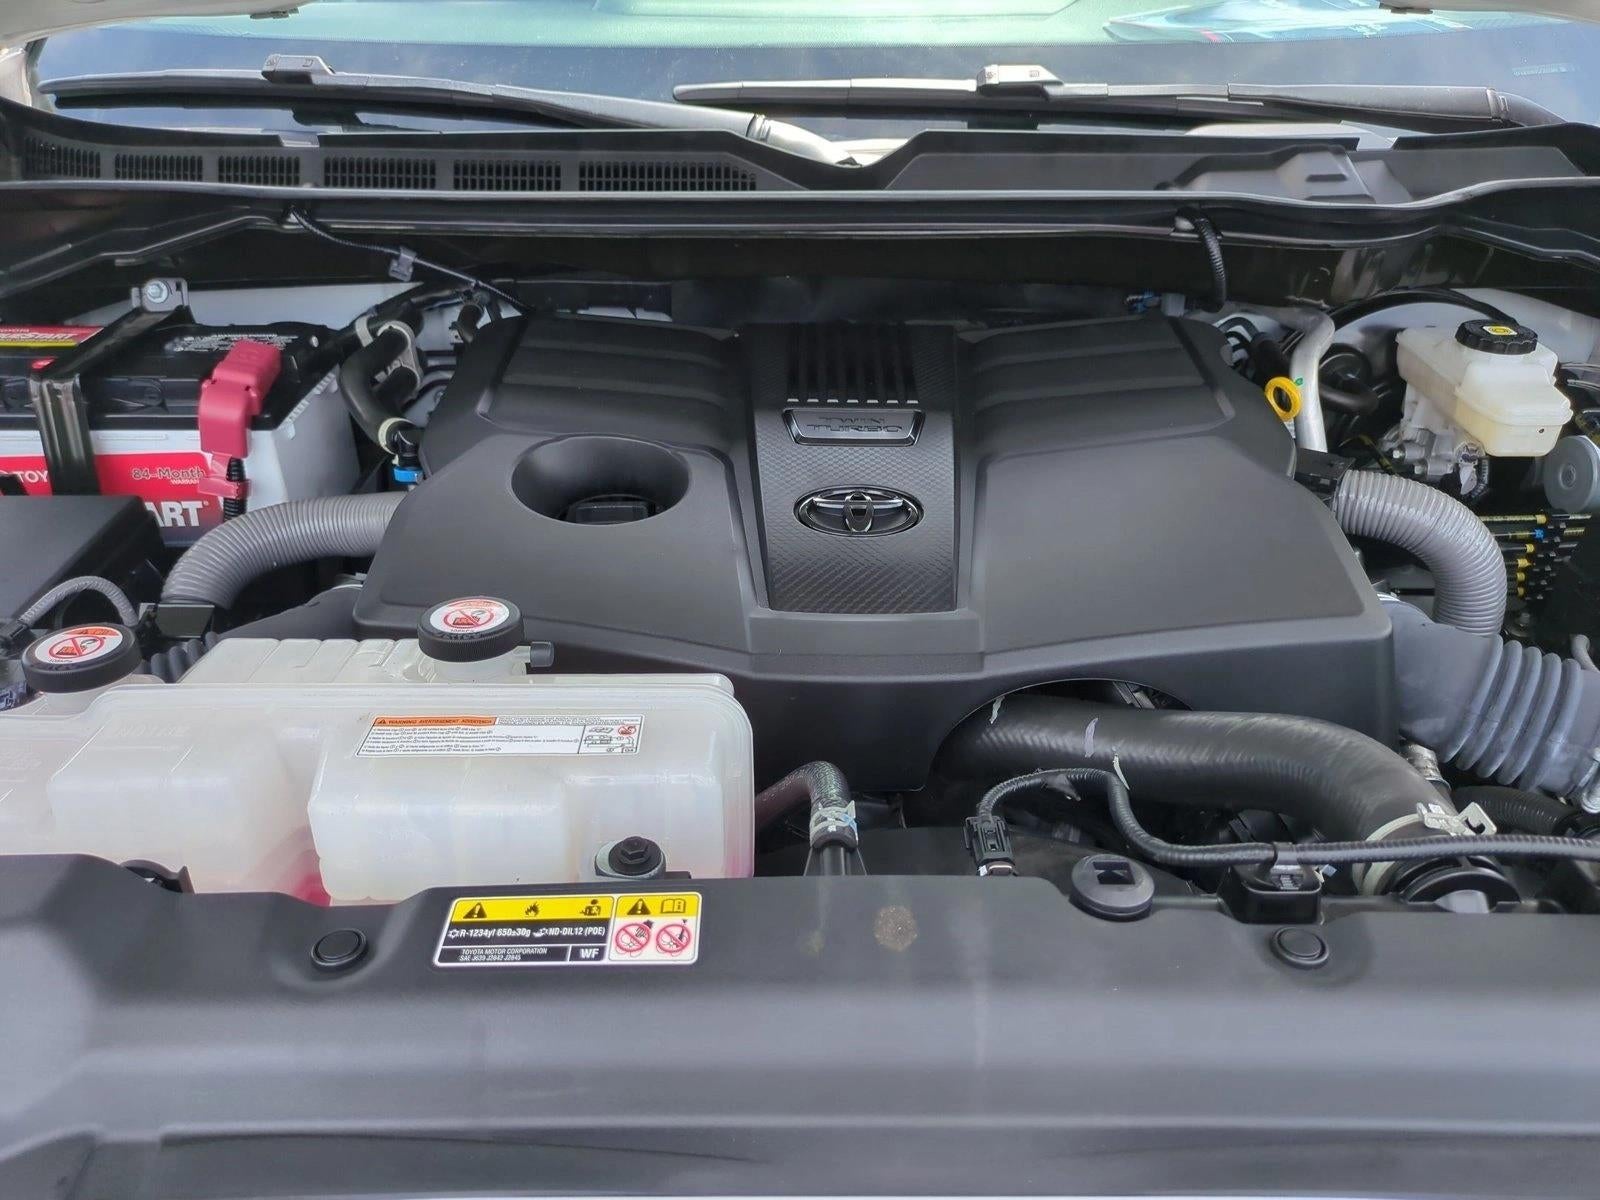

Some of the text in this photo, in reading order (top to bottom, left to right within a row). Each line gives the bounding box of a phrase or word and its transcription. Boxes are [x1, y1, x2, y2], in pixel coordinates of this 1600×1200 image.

[818, 416, 885, 424] TWIN
[806, 424, 903, 433] TURBO
[132, 465, 206, 480] 84-Month
[460, 926, 606, 938] R-1234yf 650±30g ND-OIL12 (POE)
[462, 948, 484, 956] TOYOTA
[506, 947, 548, 955] CORPORATION
[580, 947, 600, 959] WF
